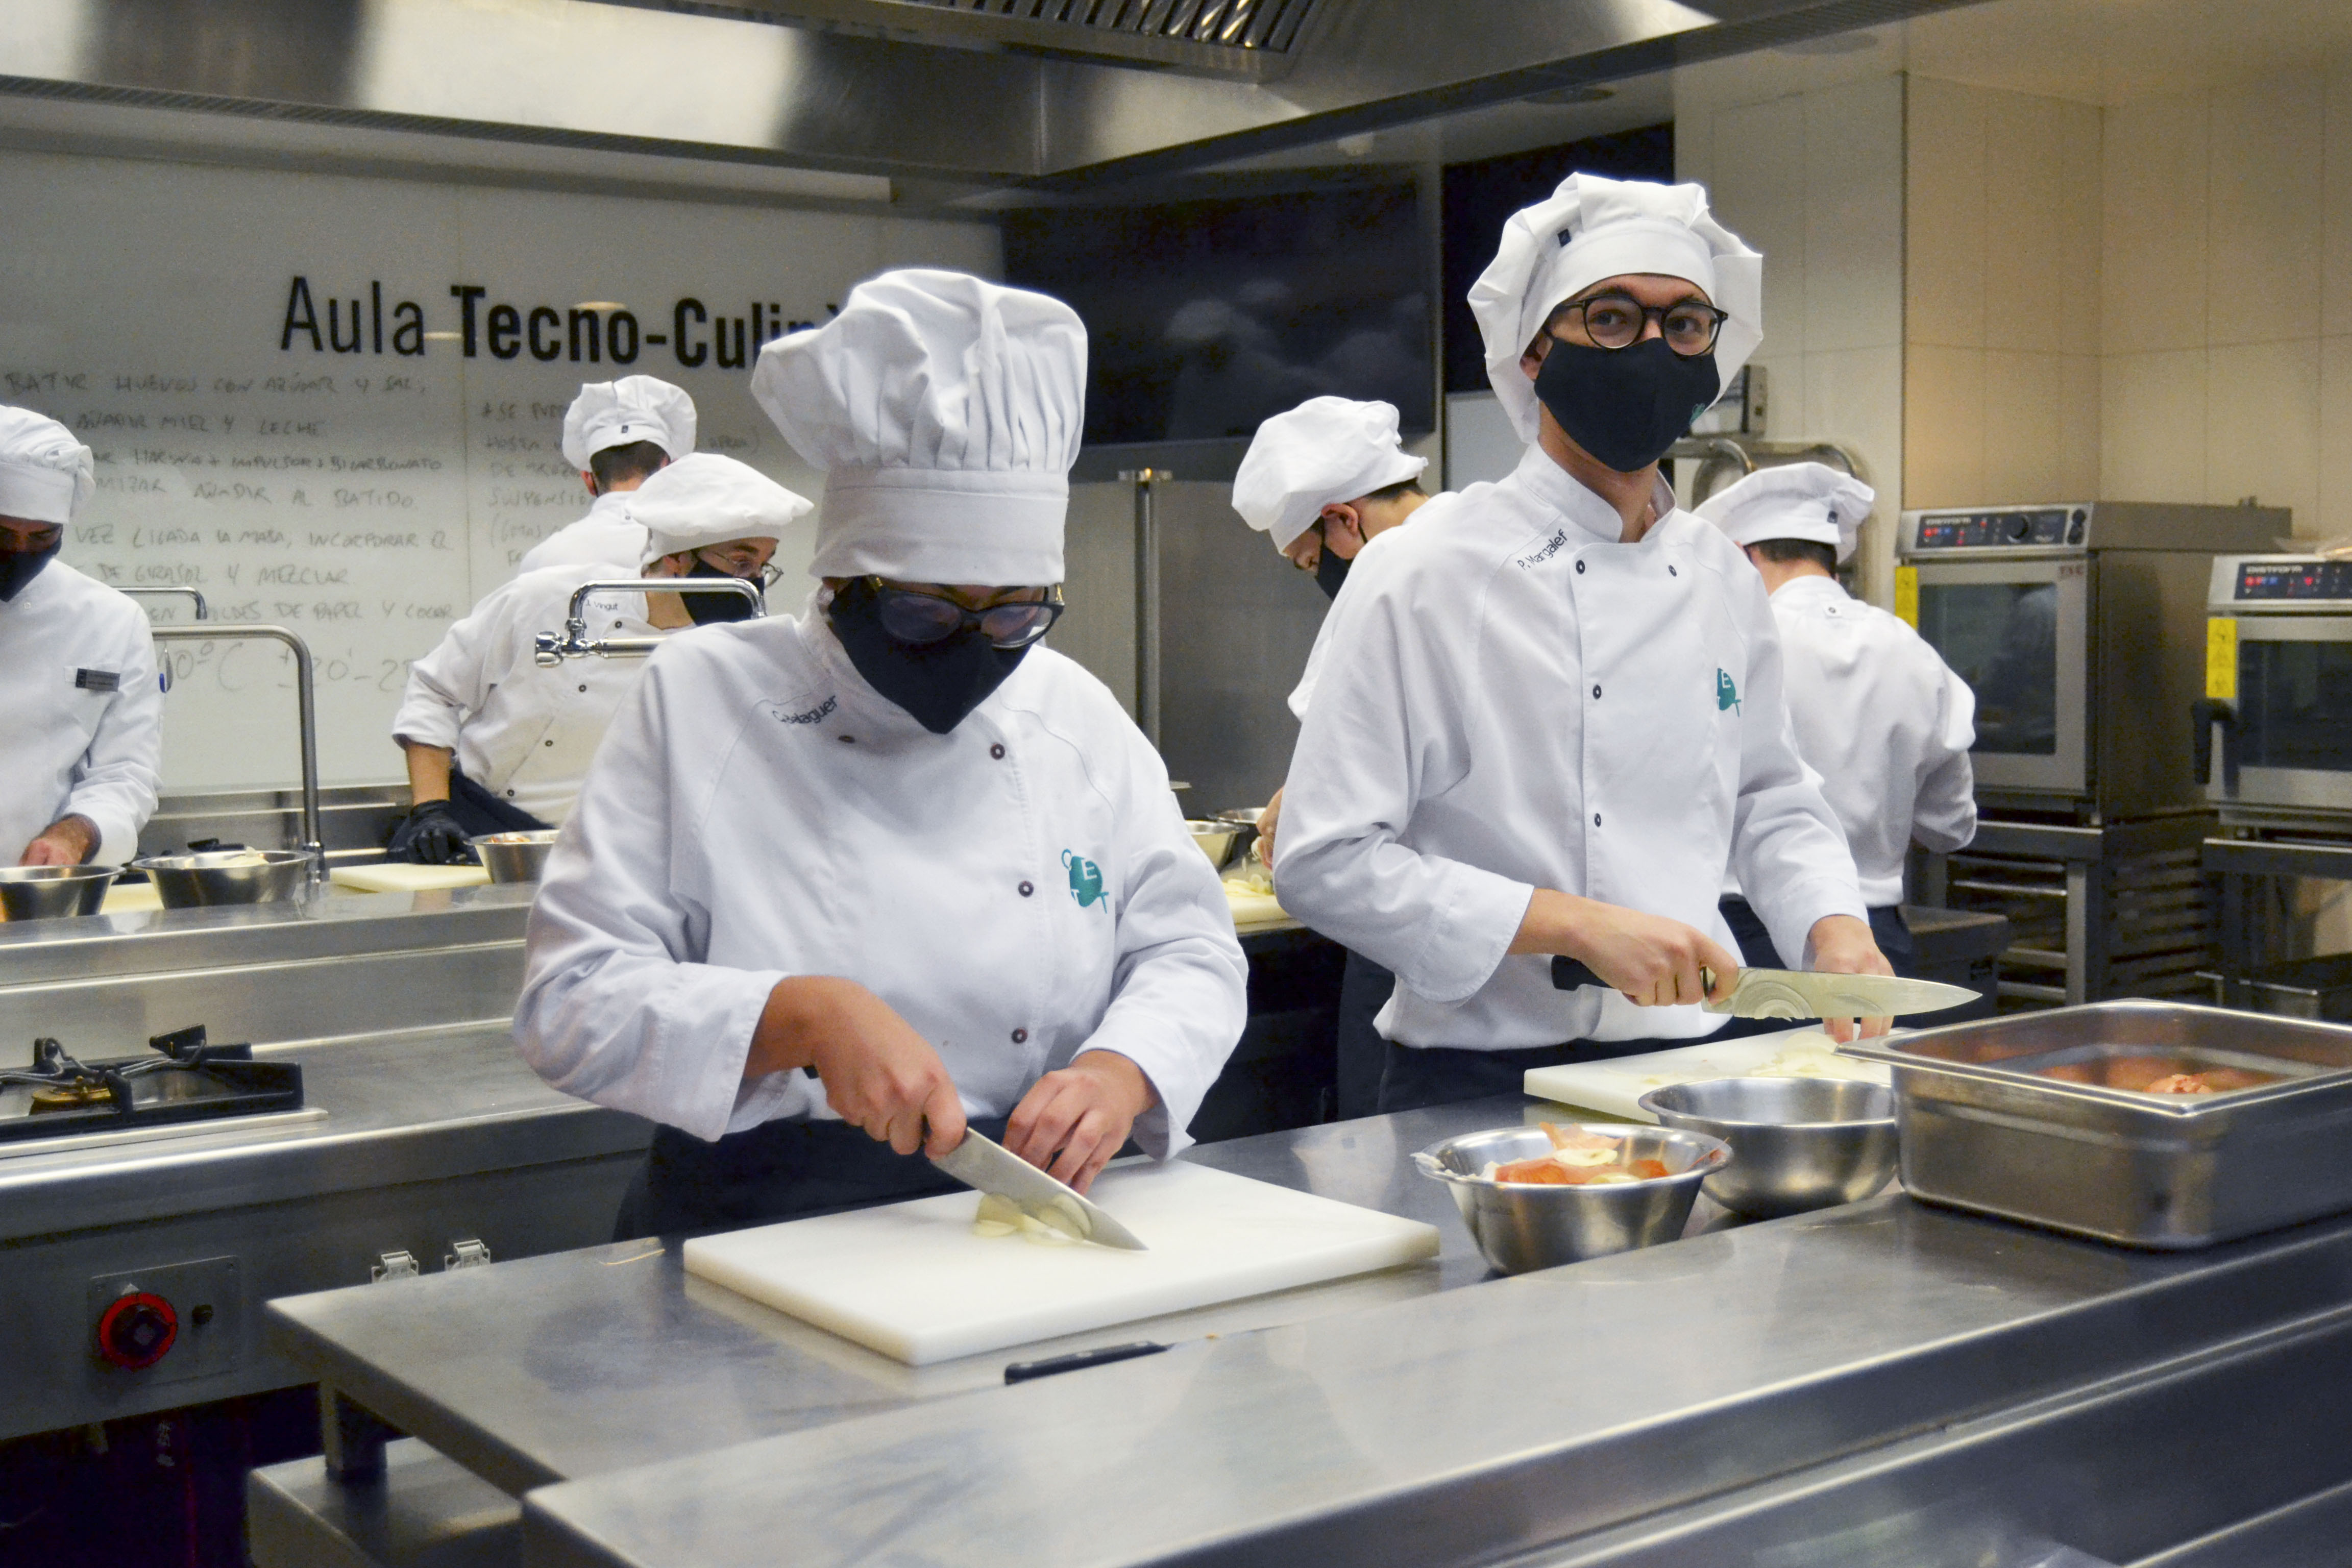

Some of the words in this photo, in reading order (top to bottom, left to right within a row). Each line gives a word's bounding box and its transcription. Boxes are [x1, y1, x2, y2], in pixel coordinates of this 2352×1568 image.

[281, 276, 425, 355] Aula
[451, 285, 839, 369] Tecno-Culi
[1525, 528, 1567, 566] Margalef
